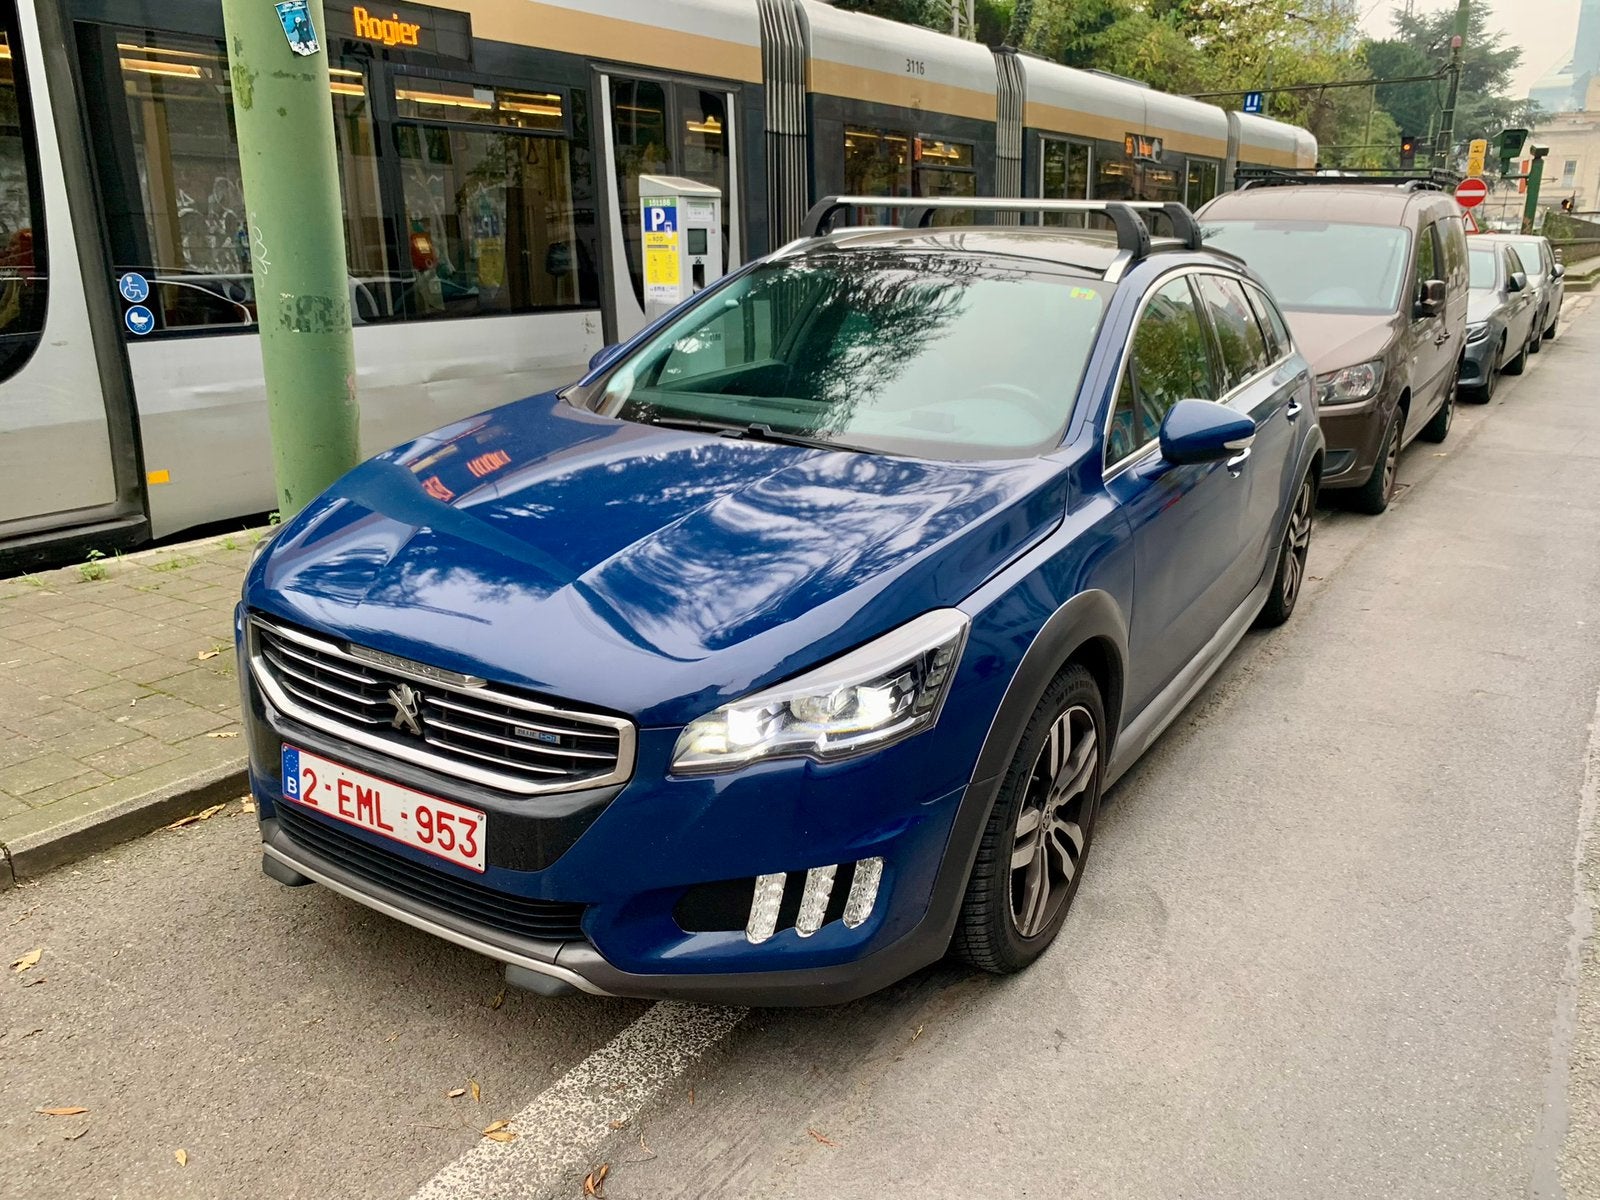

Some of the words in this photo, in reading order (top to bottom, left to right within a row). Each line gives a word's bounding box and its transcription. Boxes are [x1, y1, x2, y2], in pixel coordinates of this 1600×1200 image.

[353, 6, 420, 46] Rogier
[906, 58, 925, 75] 3116
[651, 208, 666, 232] P
[287, 776, 298, 794] B
